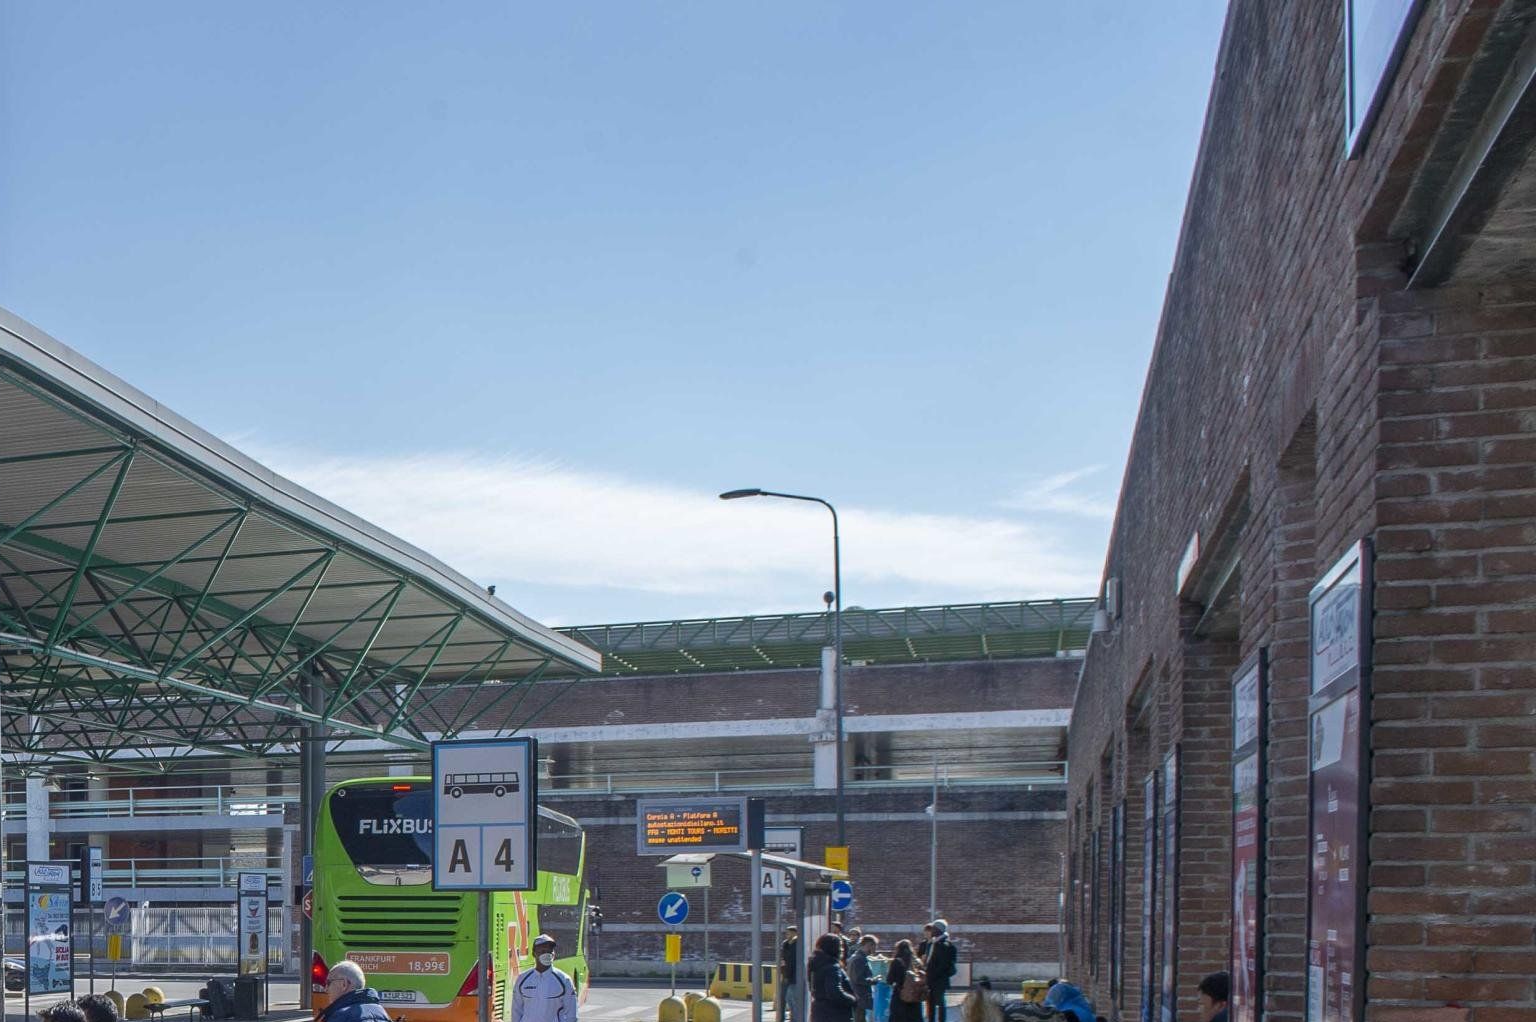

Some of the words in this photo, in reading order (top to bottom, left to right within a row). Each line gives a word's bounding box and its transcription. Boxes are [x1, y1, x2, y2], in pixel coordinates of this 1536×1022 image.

[448, 839, 472, 873] A
[494, 838, 514, 873] 4
[762, 872, 773, 888] A
[350, 955, 396, 963] FRANKFURT
[408, 960, 446, 972] 18,99€
